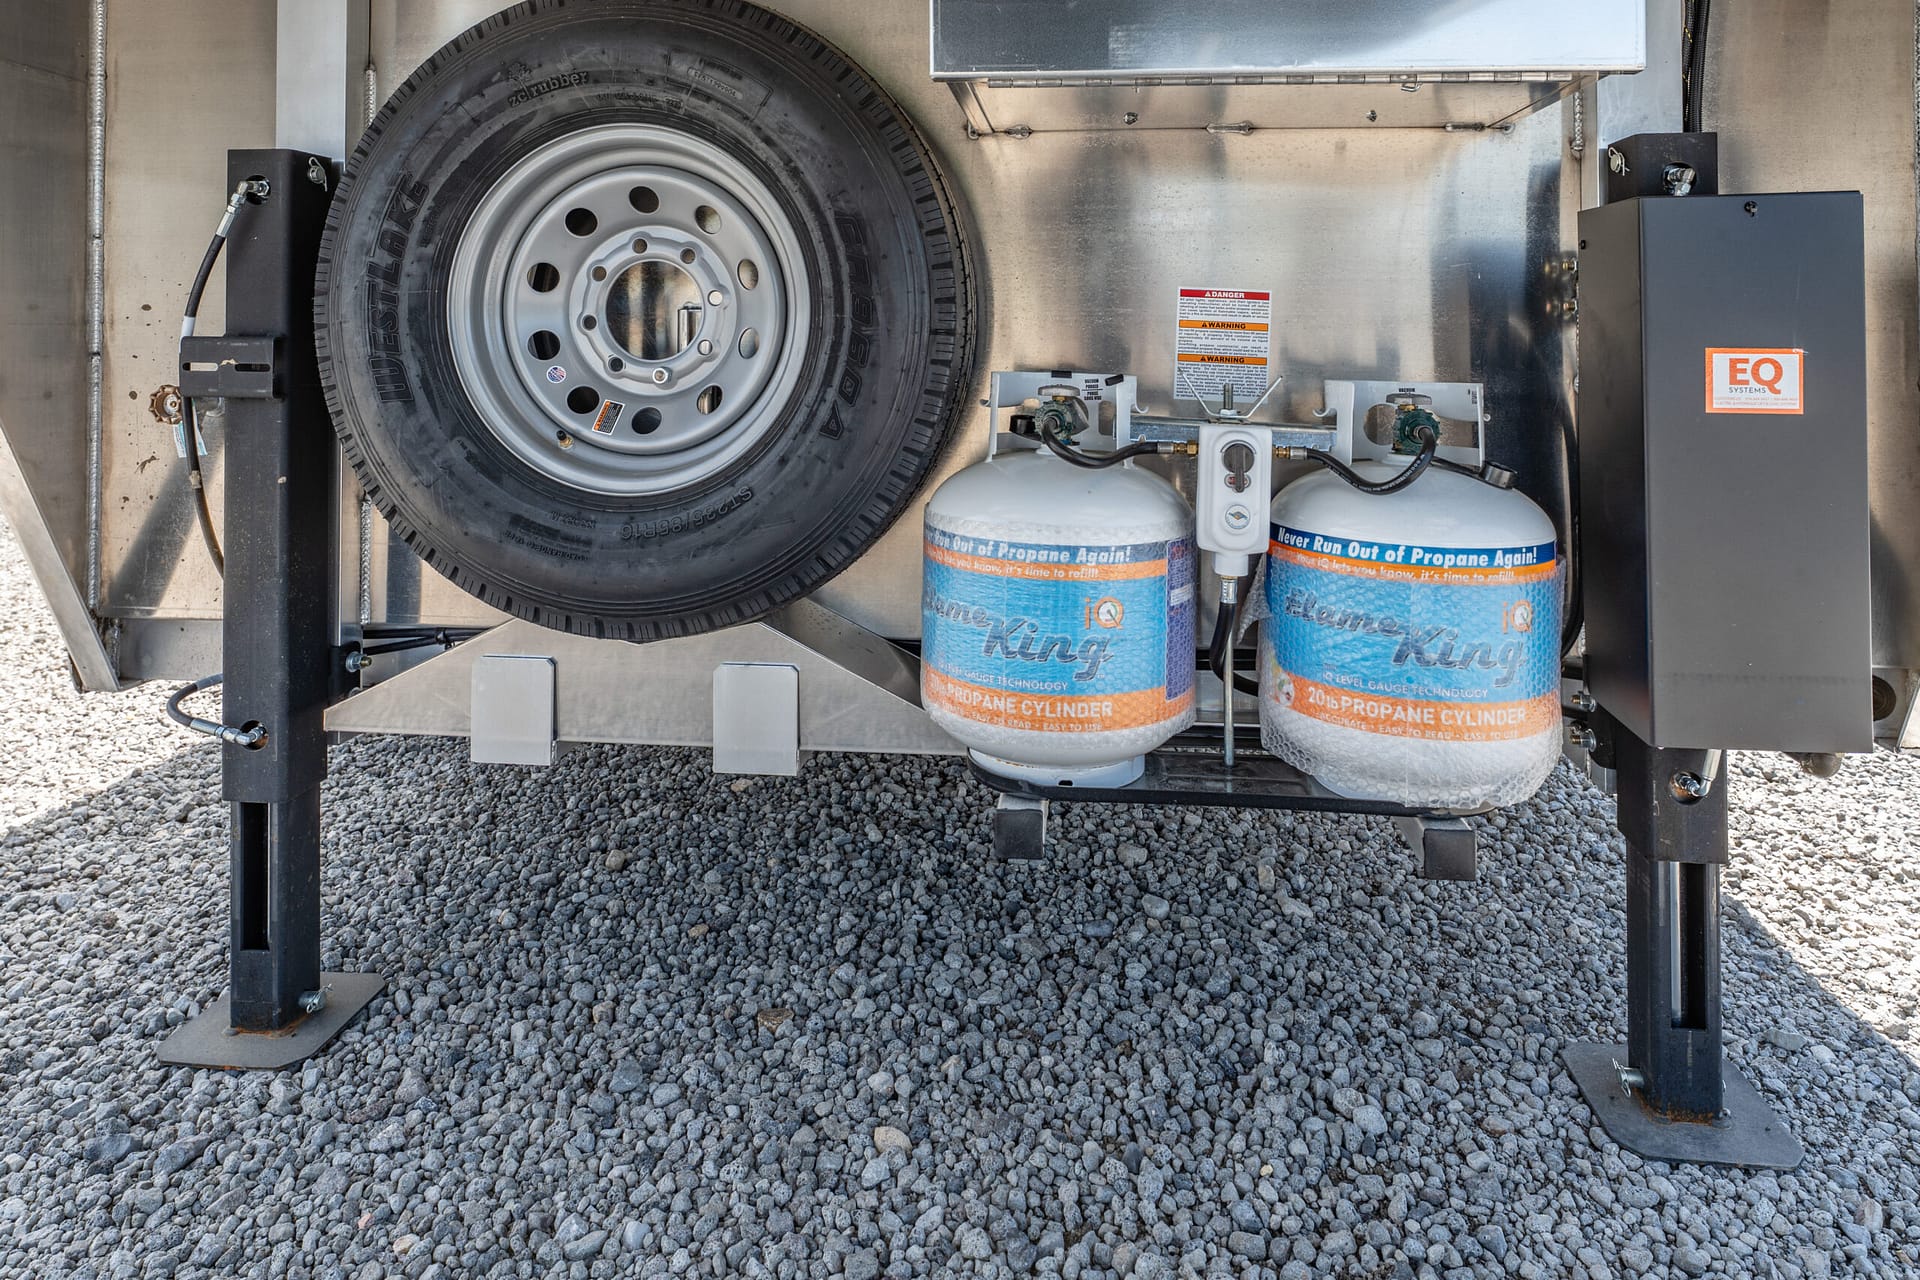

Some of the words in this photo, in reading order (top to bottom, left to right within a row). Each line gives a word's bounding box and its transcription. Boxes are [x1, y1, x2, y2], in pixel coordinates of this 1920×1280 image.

[531, 70, 589, 97] rubber
[367, 172, 430, 402] WESTLAKE
[1211, 291, 1244, 299] DANGER
[1208, 322, 1246, 330] WARNING
[1207, 356, 1245, 364] WARNING
[1728, 357, 1783, 395] EQ
[1728, 386, 1766, 394] SYSTEMS
[953, 536, 974, 554] Out
[978, 541, 994, 557] of
[998, 542, 1070, 563] Propane
[1076, 546, 1131, 566] Again!
[1278, 527, 1309, 549] Never
[1313, 535, 1342, 555] Run
[1348, 541, 1379, 560] Out
[1385, 547, 1405, 562] of
[1411, 548, 1488, 568] Propane
[1494, 546, 1537, 568] Again!
[1054, 568, 1065, 577] to
[1333, 559, 1351, 573] lets
[1353, 563, 1376, 577] you
[1443, 571, 1469, 582] time
[1473, 572, 1485, 582] to
[983, 617, 1114, 682] King
[1286, 588, 1404, 636] Flame
[1392, 625, 1526, 688] King
[996, 676, 1068, 690] TECHNOLOGY
[1336, 673, 1364, 688] LEVEL
[1368, 680, 1409, 695] GAUGE
[1411, 684, 1488, 698] TECHNOLOGY
[947, 680, 1017, 714] PROPANE
[1021, 699, 1113, 718] CYLINDER
[1341, 694, 1435, 724] PROPANE
[1441, 706, 1526, 726] CYLINDER
